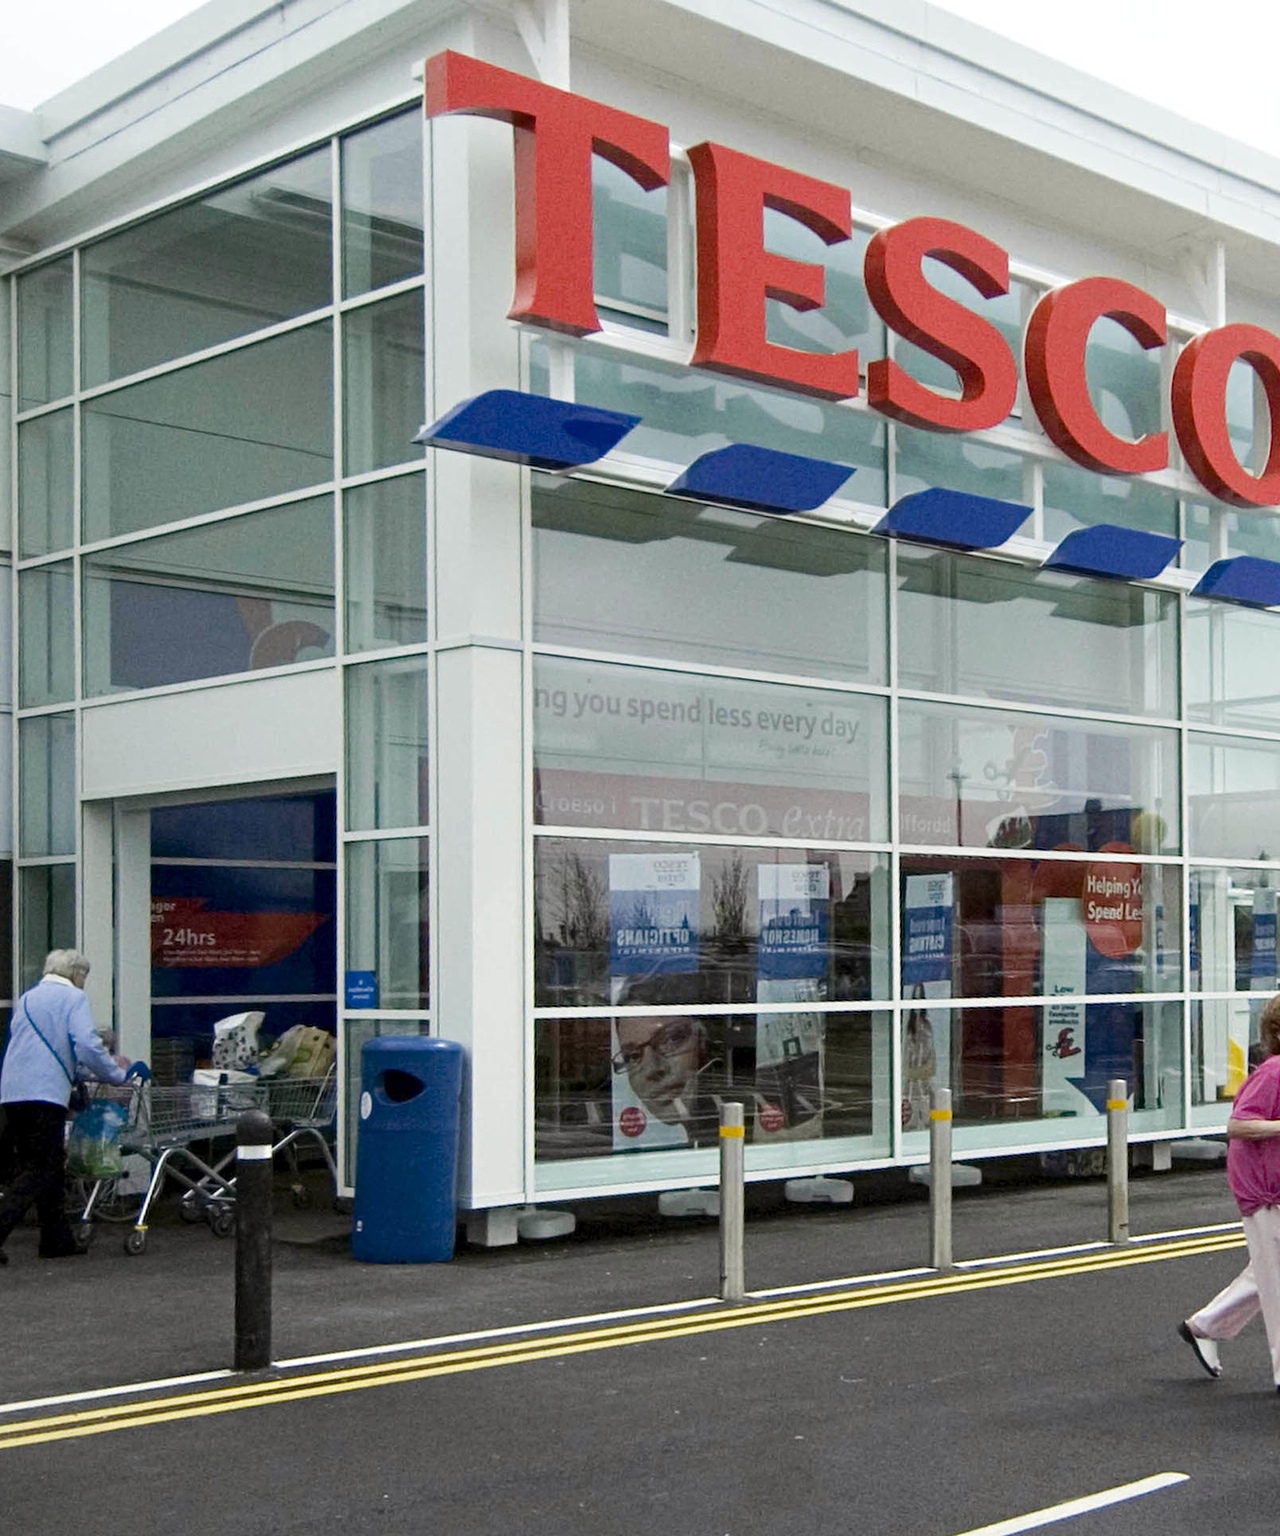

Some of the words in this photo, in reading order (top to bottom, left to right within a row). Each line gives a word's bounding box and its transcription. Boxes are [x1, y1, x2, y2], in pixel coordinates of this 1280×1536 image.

[573, 690, 621, 719] you
[626, 695, 702, 725] spend
[708, 698, 752, 728] less
[758, 707, 817, 739] every
[822, 711, 860, 744] day
[631, 796, 768, 836] TESCO
[781, 804, 866, 842] extra
[1087, 874, 1130, 898] Helping
[1087, 901, 1124, 923] Spend
[163, 928, 217, 946] 24hrs
[1054, 983, 1074, 994] Low
